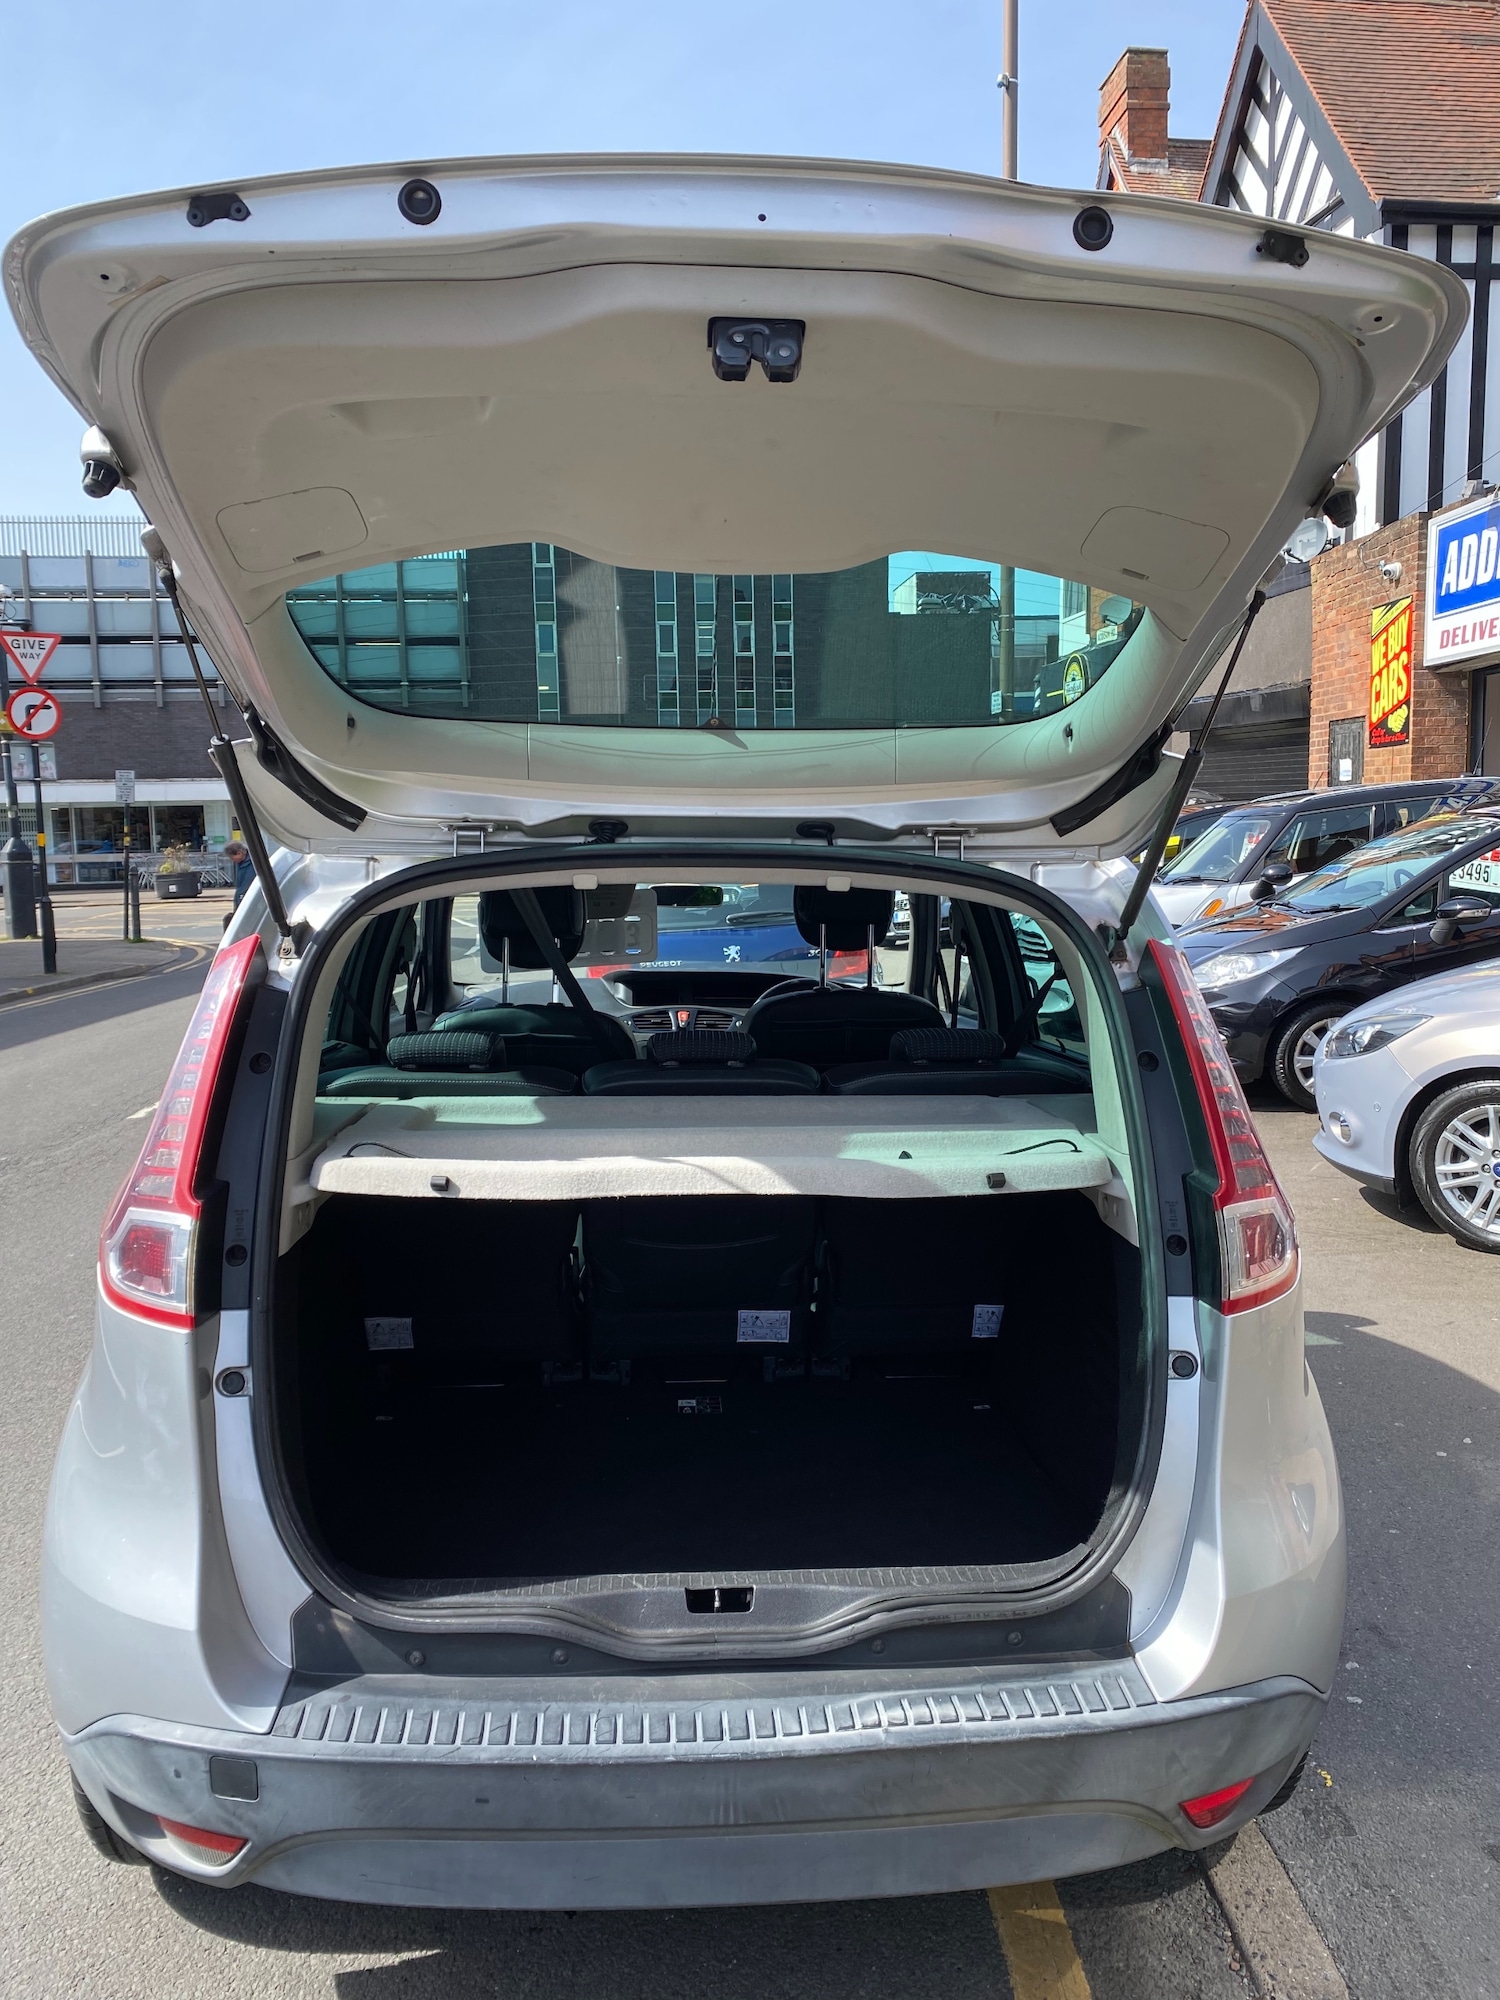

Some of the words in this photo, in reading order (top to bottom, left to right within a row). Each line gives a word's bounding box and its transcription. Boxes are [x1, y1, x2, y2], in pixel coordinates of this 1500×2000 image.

[1440, 526, 1500, 596] ADD
[11, 639, 46, 650] GIVE
[1371, 632, 1387, 677] WE
[1388, 609, 1410, 661] BUY
[1439, 617, 1500, 649] DELIVE
[19, 652, 41, 660] WAY
[1371, 651, 1408, 723] CARS
[639, 960, 682, 968] PEUGEOT
